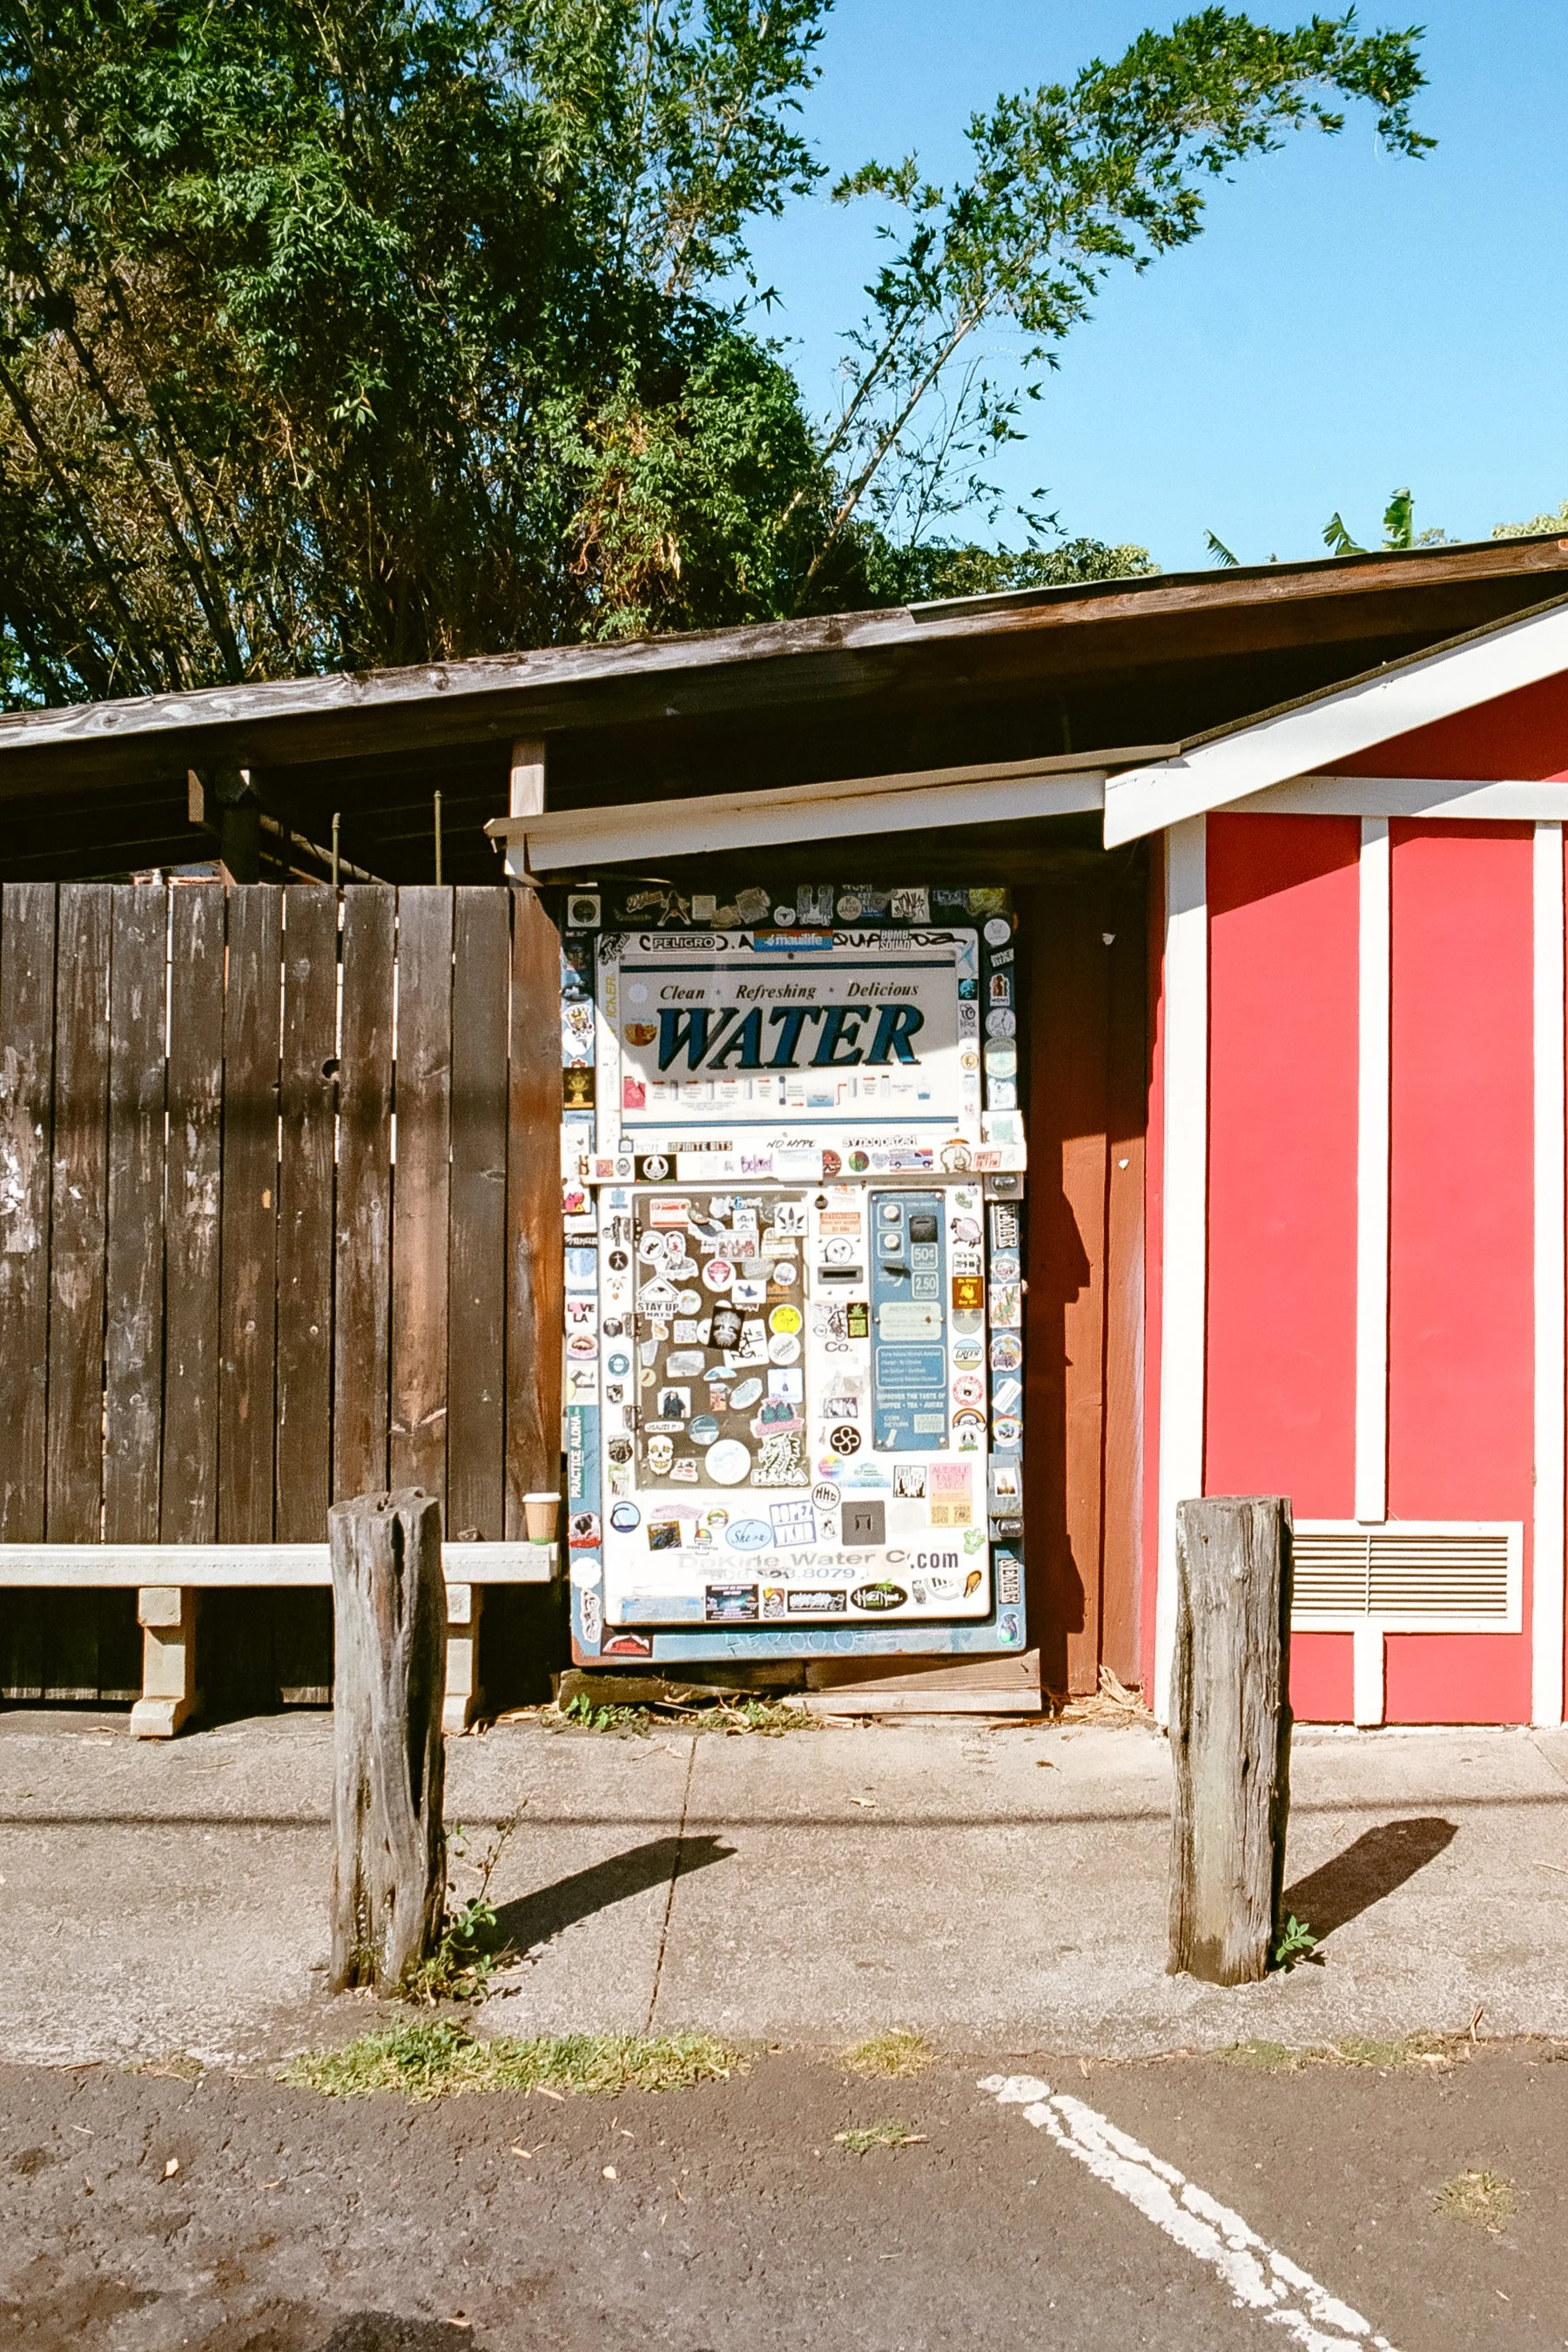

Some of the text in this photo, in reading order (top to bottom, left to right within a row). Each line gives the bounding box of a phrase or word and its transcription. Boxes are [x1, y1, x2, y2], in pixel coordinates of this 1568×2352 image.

[654, 938, 715, 949] PELIGRO
[660, 981, 919, 1001] Clean Refreshing Delicious
[656, 1003, 925, 1072] WATER
[668, 1141, 732, 1152] INFINITE BITS
[786, 1138, 818, 1148] HYPE
[637, 1302, 679, 1311] STAY UP
[573, 1313, 589, 1323] LA
[570, 1415, 582, 1499] PRACTICE ALOHA
[791, 1550, 876, 1566] Water
